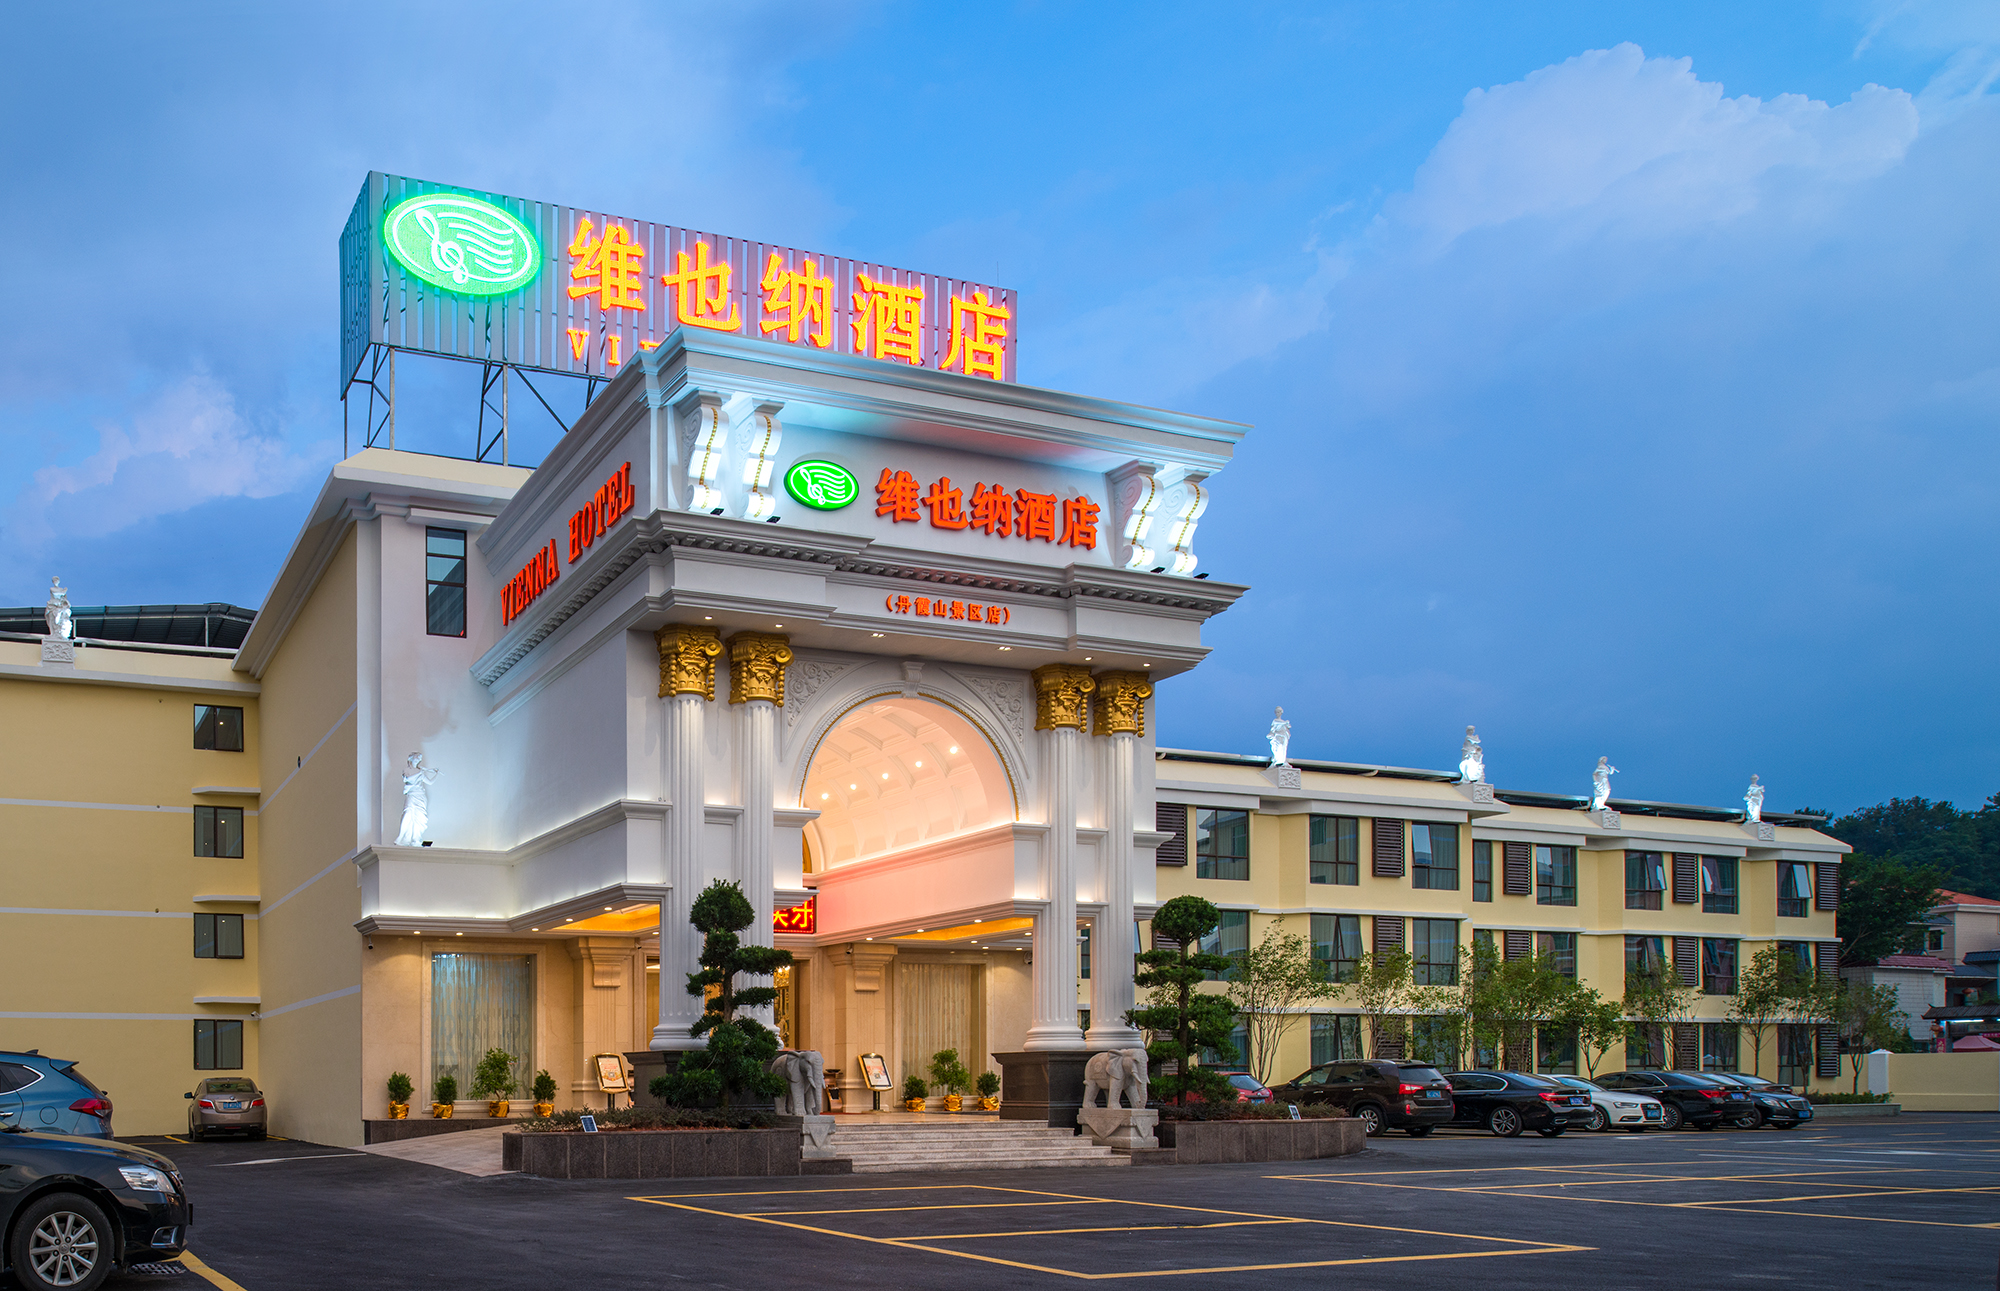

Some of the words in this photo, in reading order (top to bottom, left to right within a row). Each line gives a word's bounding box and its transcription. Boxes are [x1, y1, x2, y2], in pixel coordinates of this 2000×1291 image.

[567, 217, 1011, 381] 维也纳酒店
[500, 538, 560, 626] VIENNA
[568, 461, 635, 564] HOTEL
[875, 467, 1101, 550] 维也纳酒店
